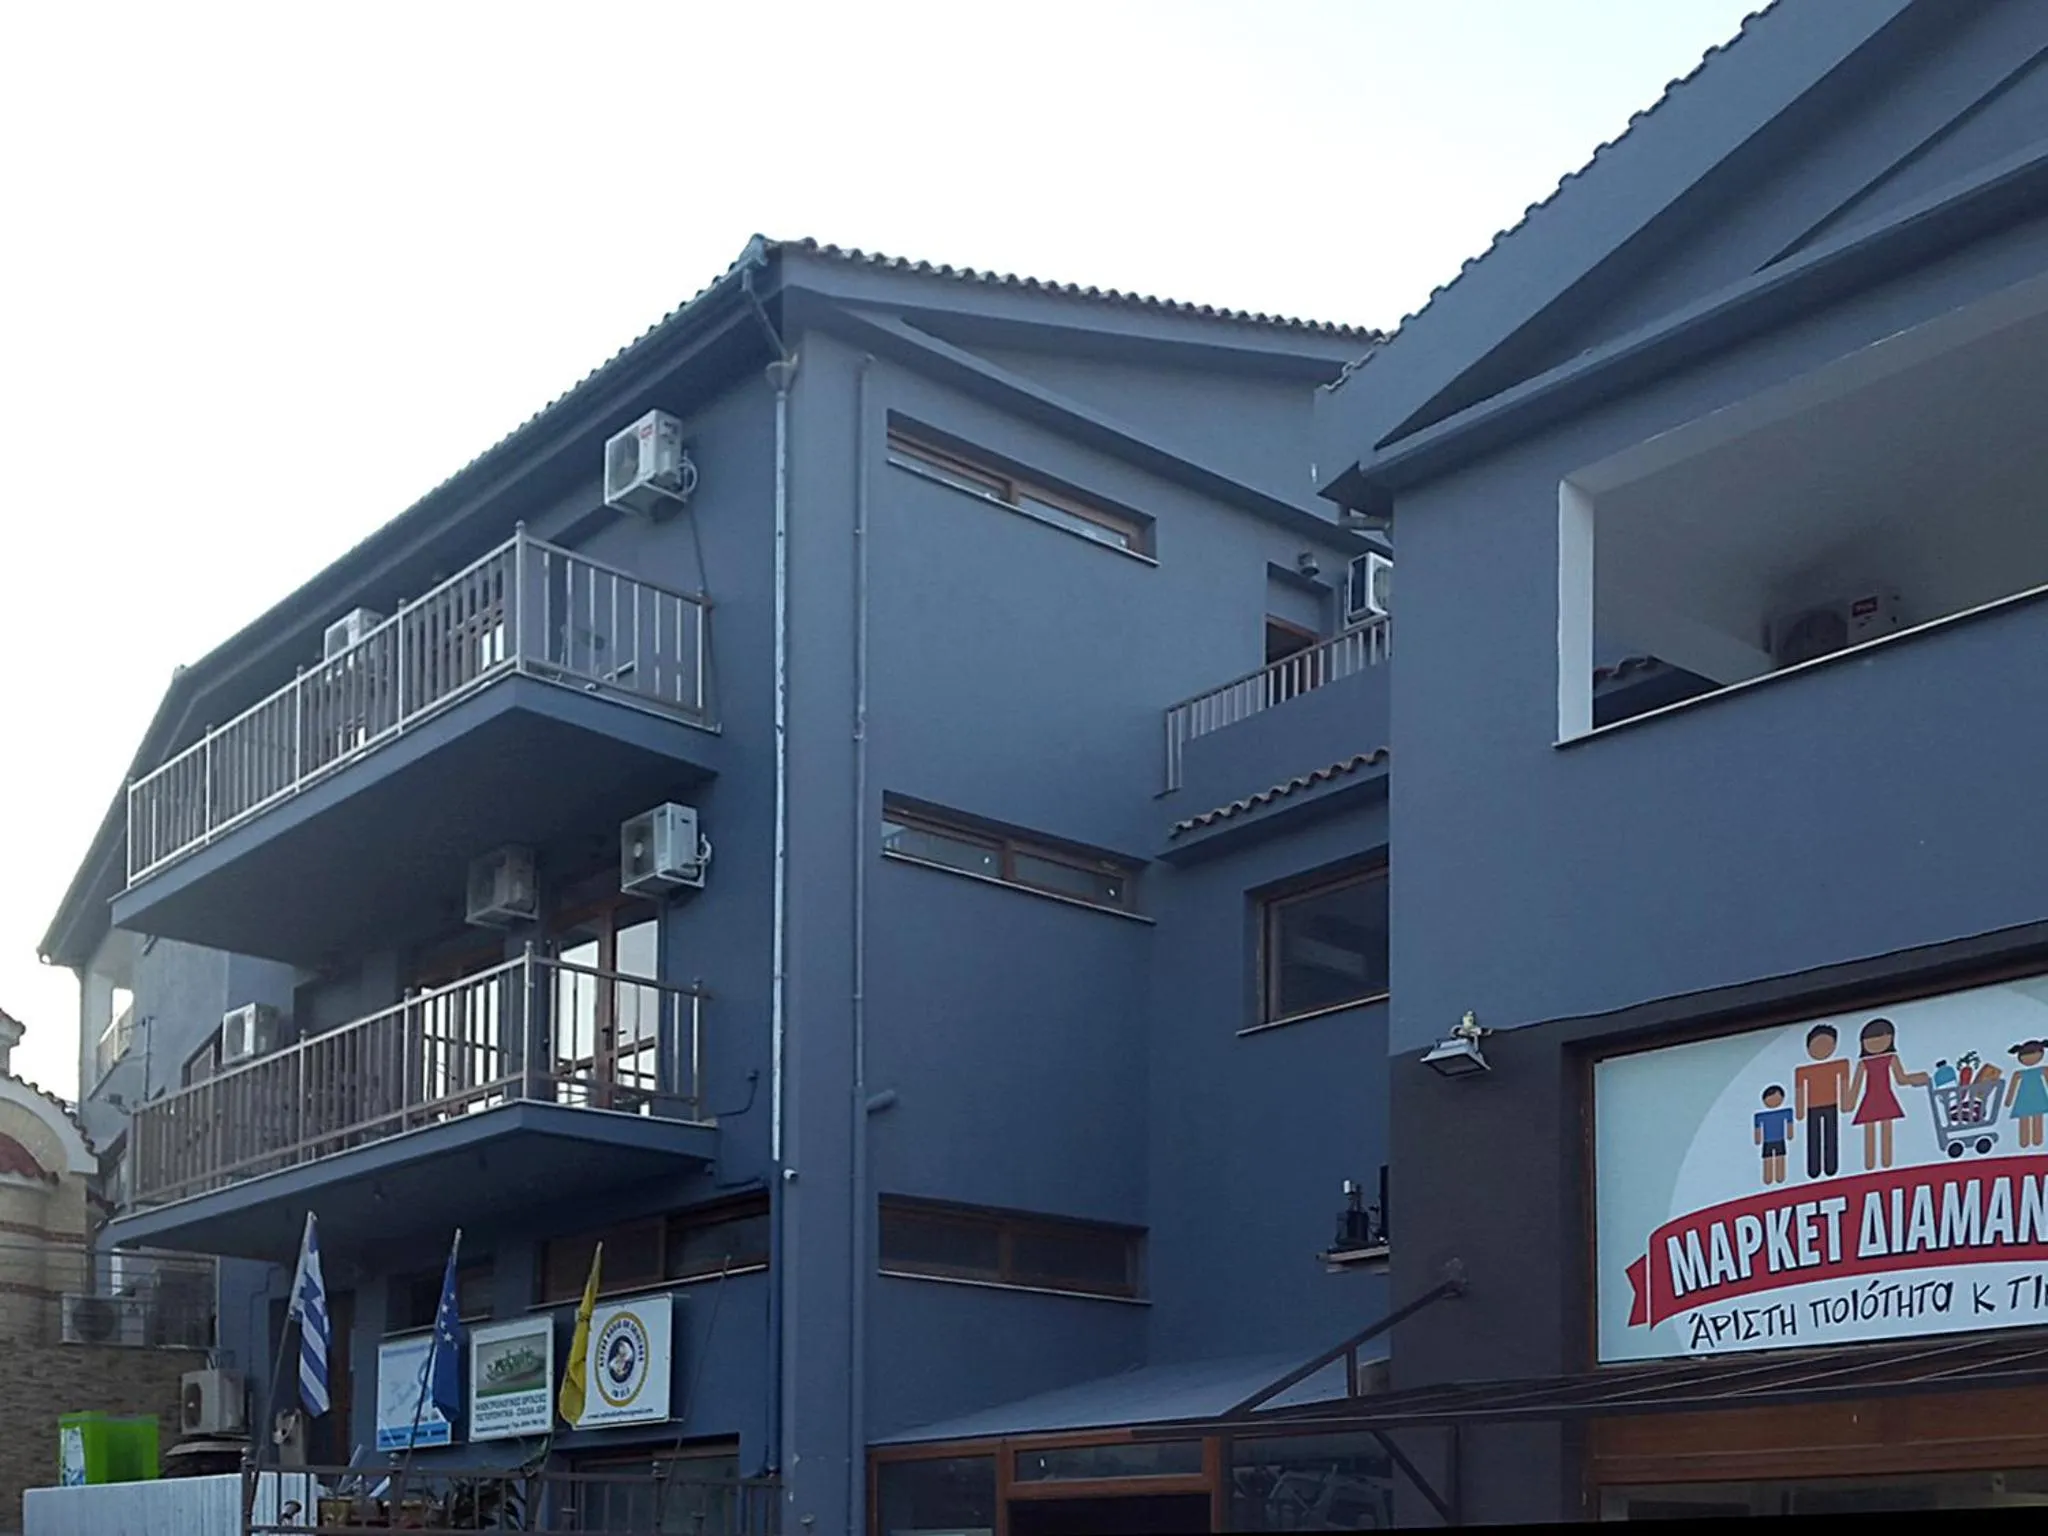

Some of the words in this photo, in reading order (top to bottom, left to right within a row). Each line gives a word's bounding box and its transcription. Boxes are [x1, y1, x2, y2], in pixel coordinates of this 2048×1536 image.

[1666, 1196, 1847, 1298] ΜΑΡΚΕΤ
[1688, 1303, 1798, 1349] ΆΡΙΣΤΗ
[2007, 1274, 2048, 1310] ΤΙ
